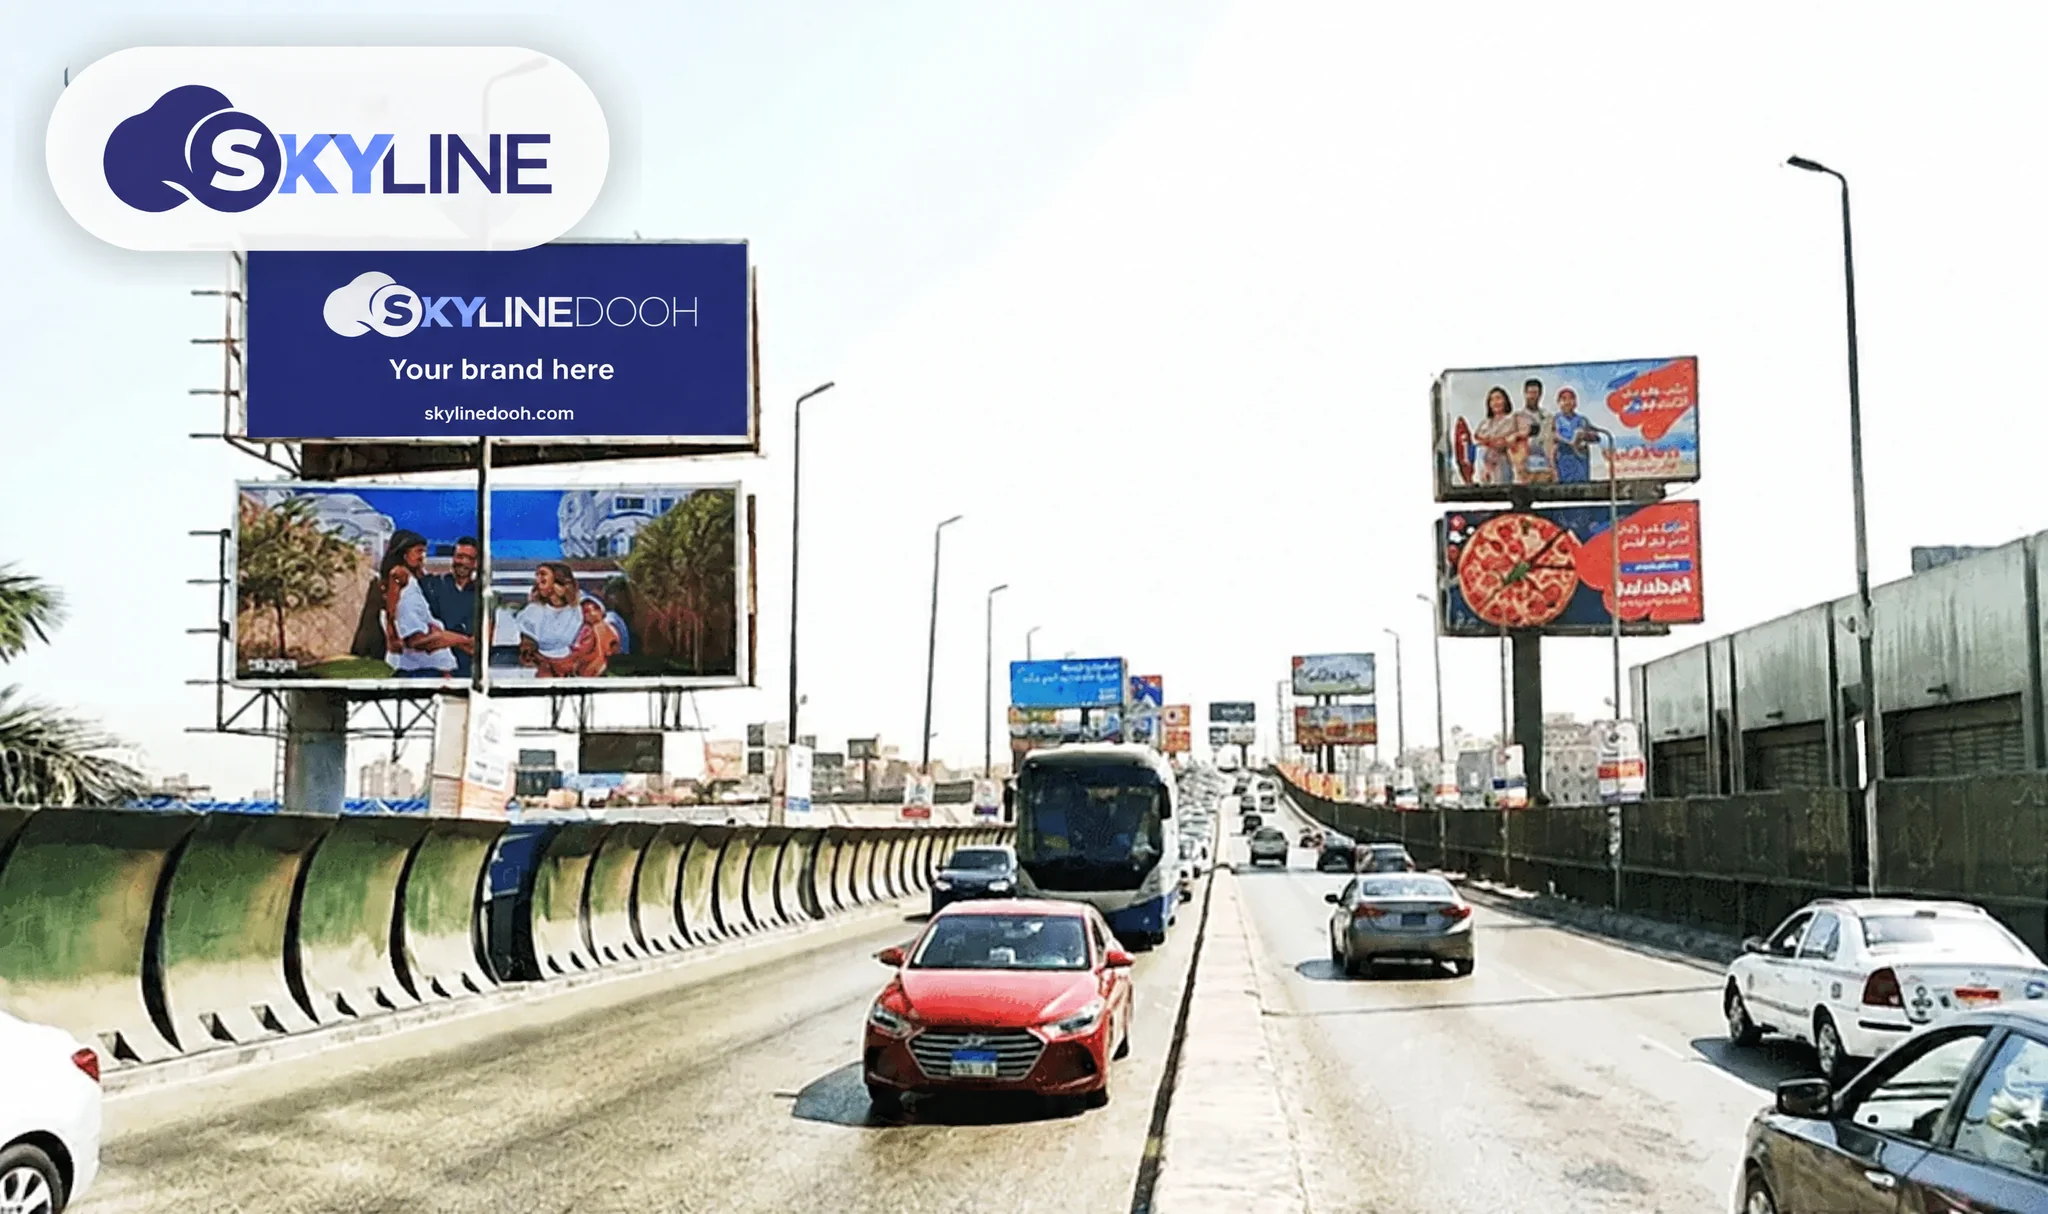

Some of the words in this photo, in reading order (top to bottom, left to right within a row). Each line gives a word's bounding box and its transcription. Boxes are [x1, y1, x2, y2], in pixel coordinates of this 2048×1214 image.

[389, 358, 454, 380] Your
[461, 358, 543, 380] brand
[553, 358, 615, 380] here
[424, 405, 574, 424] skylinedooh.com
